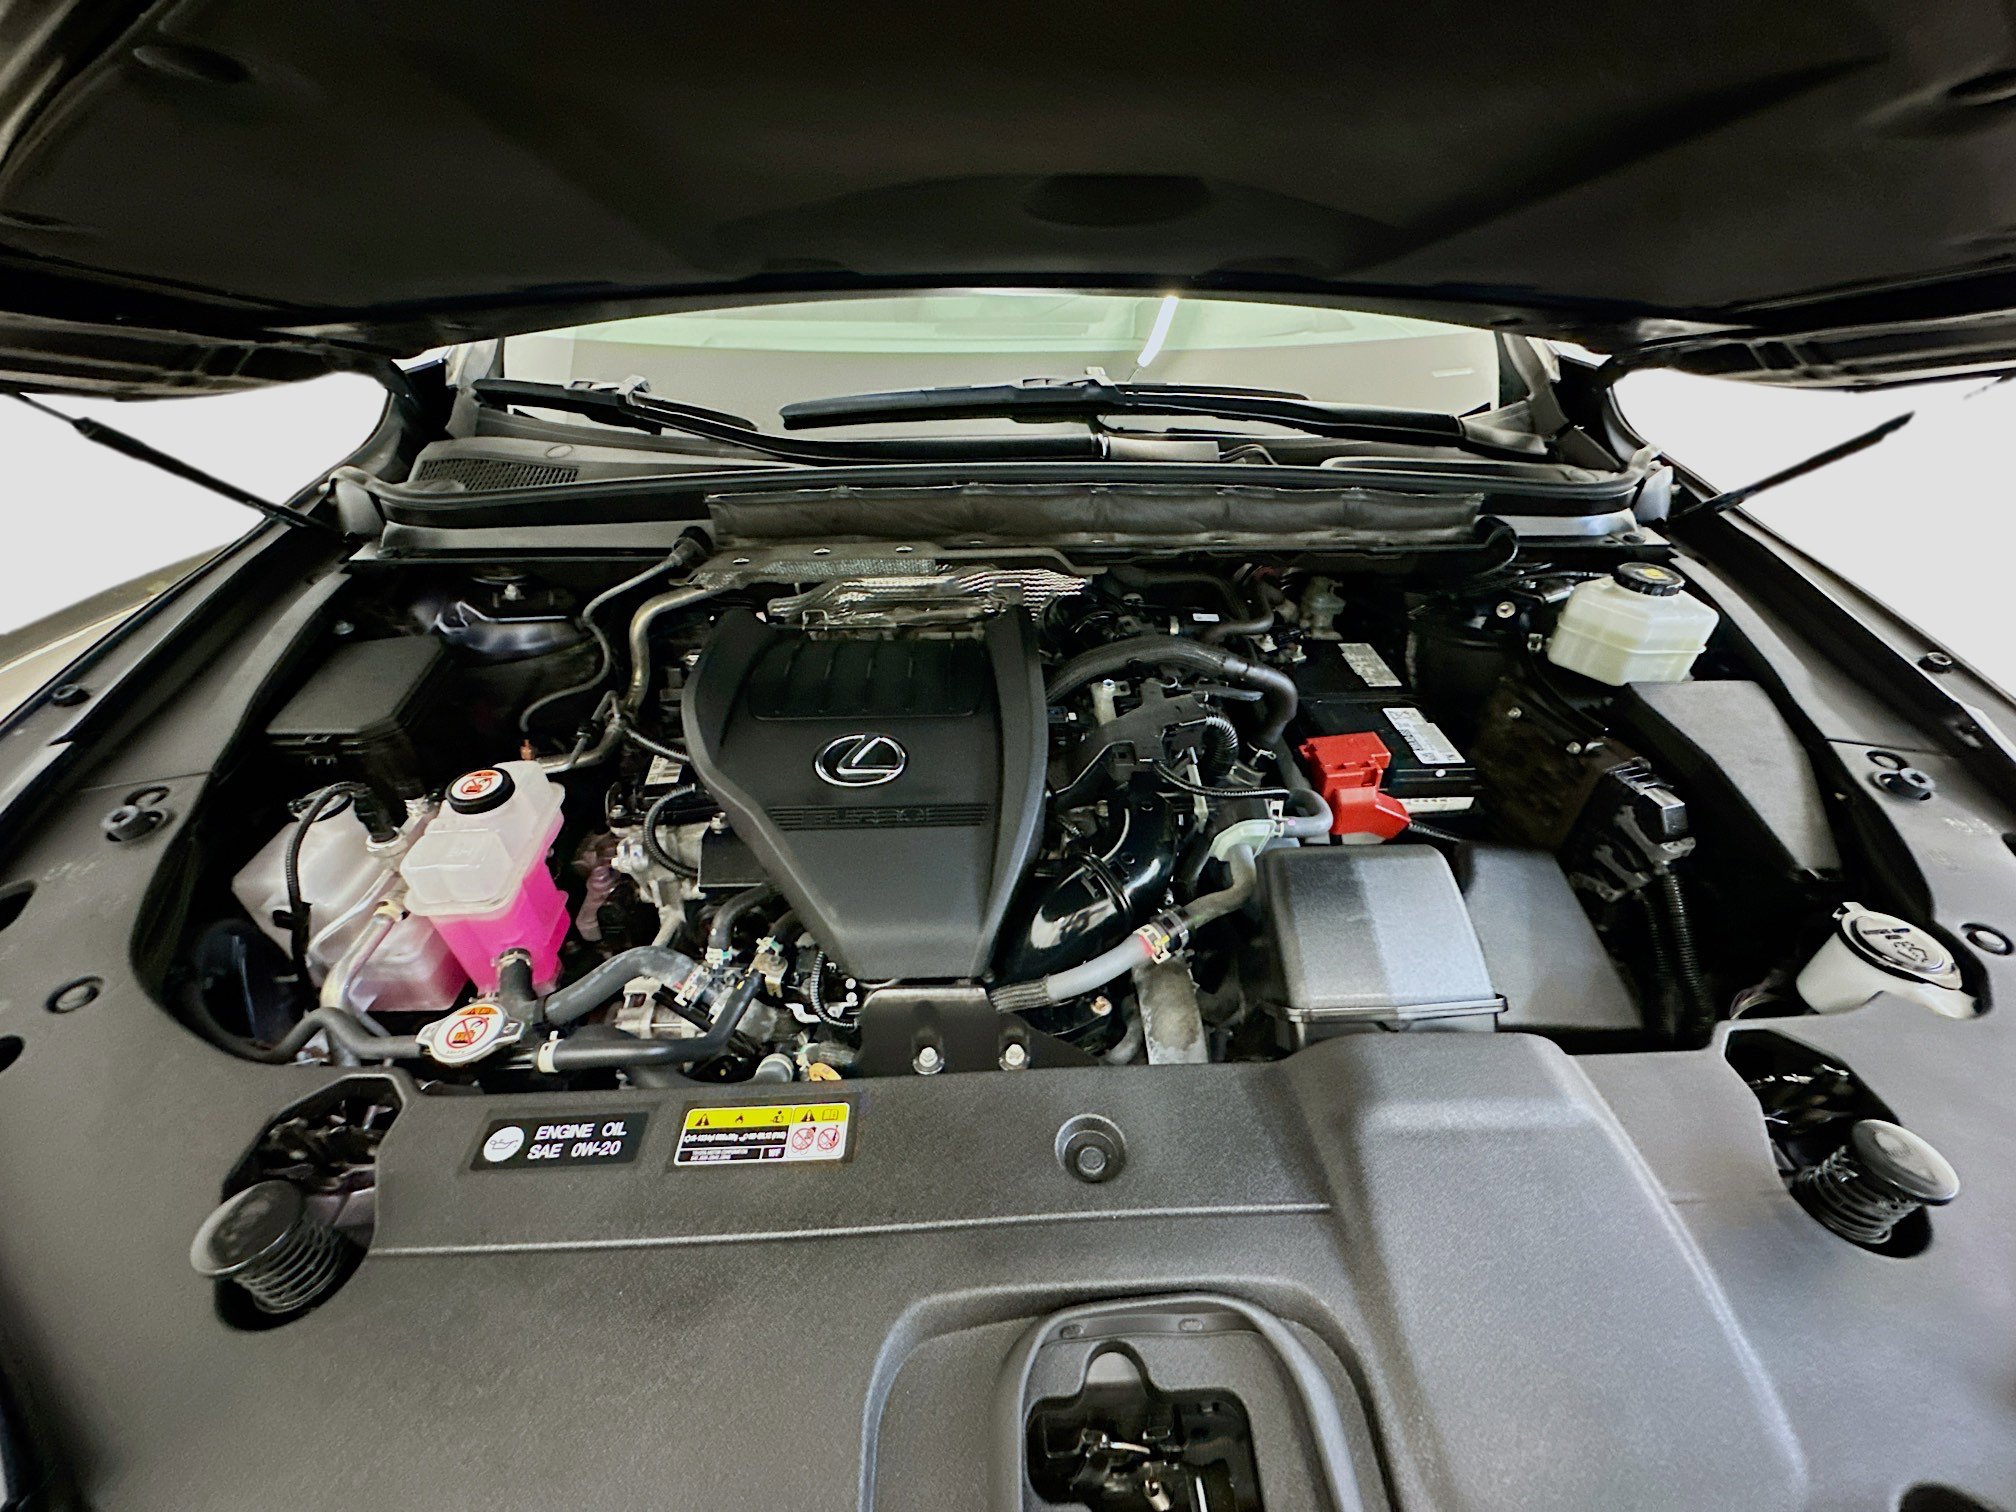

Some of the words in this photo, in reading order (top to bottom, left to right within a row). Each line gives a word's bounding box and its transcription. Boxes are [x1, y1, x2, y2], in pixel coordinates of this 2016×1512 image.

[534, 1123, 595, 1141] ENGINE
[601, 1121, 628, 1137] OIL
[526, 1143, 564, 1160] SAE
[570, 1140, 622, 1158] 0W-20
